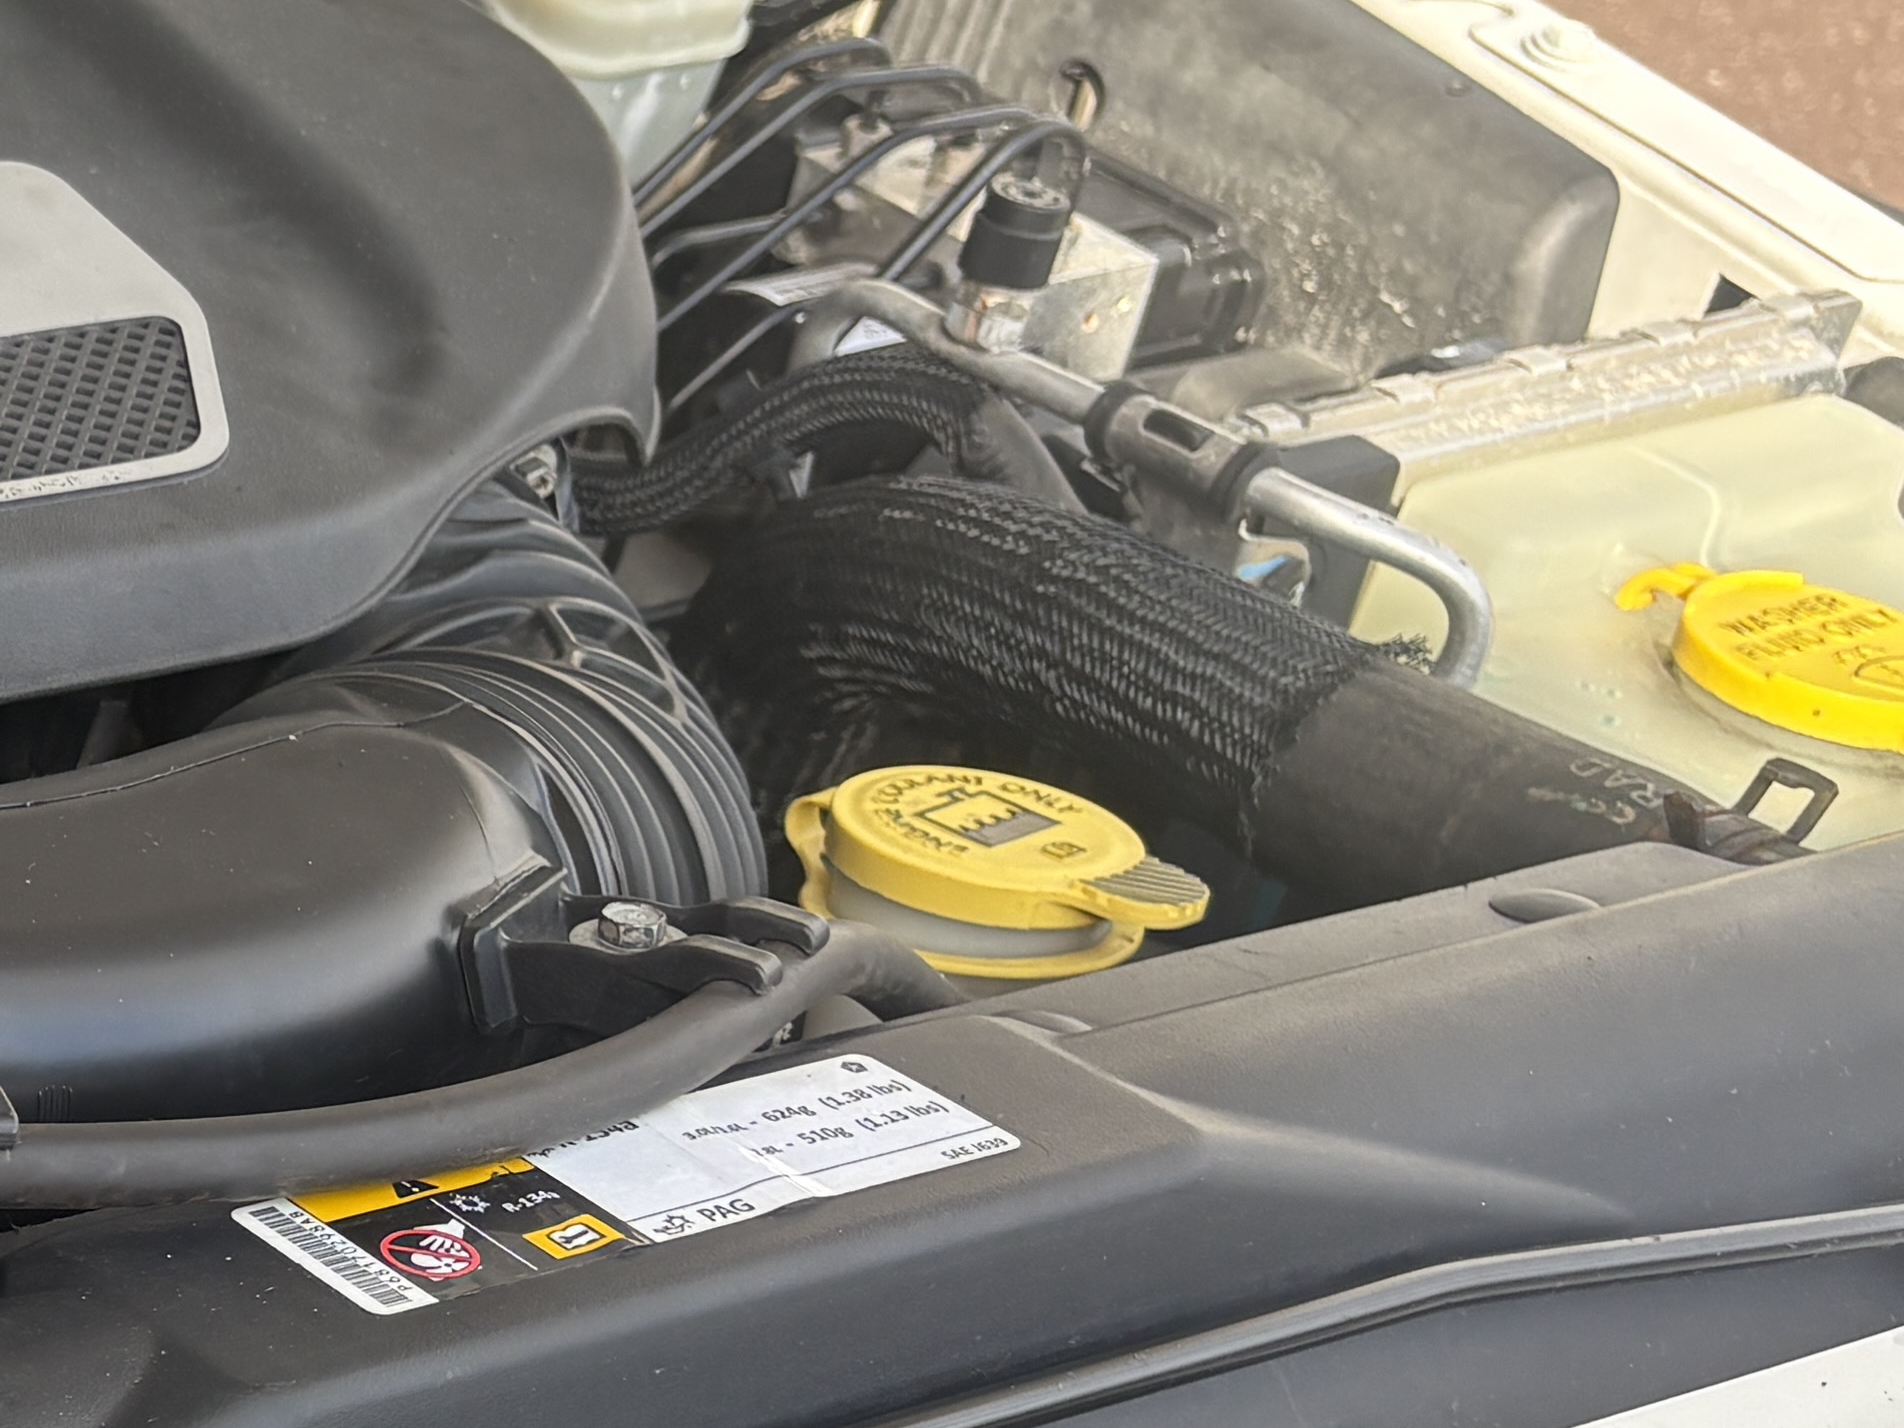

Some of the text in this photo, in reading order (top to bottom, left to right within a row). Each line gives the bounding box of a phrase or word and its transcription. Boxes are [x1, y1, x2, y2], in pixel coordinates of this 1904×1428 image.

[1719, 593, 1848, 636] WASHER
[1736, 608, 1898, 661] FLUID ONLY
[872, 773, 985, 805] COOLANT
[998, 782, 1084, 815] ONLY
[761, 1104, 817, 1122] 624g
[817, 1087, 873, 1110] (1.38
[870, 1079, 913, 1098] lbs)
[798, 1125, 854, 1145] 510g
[855, 1109, 910, 1132] (1.13
[904, 1100, 950, 1119] lbs)
[940, 1146, 975, 1161] SAE
[694, 1197, 756, 1223] PAG
[288, 1210, 415, 1293] P68170298AB
